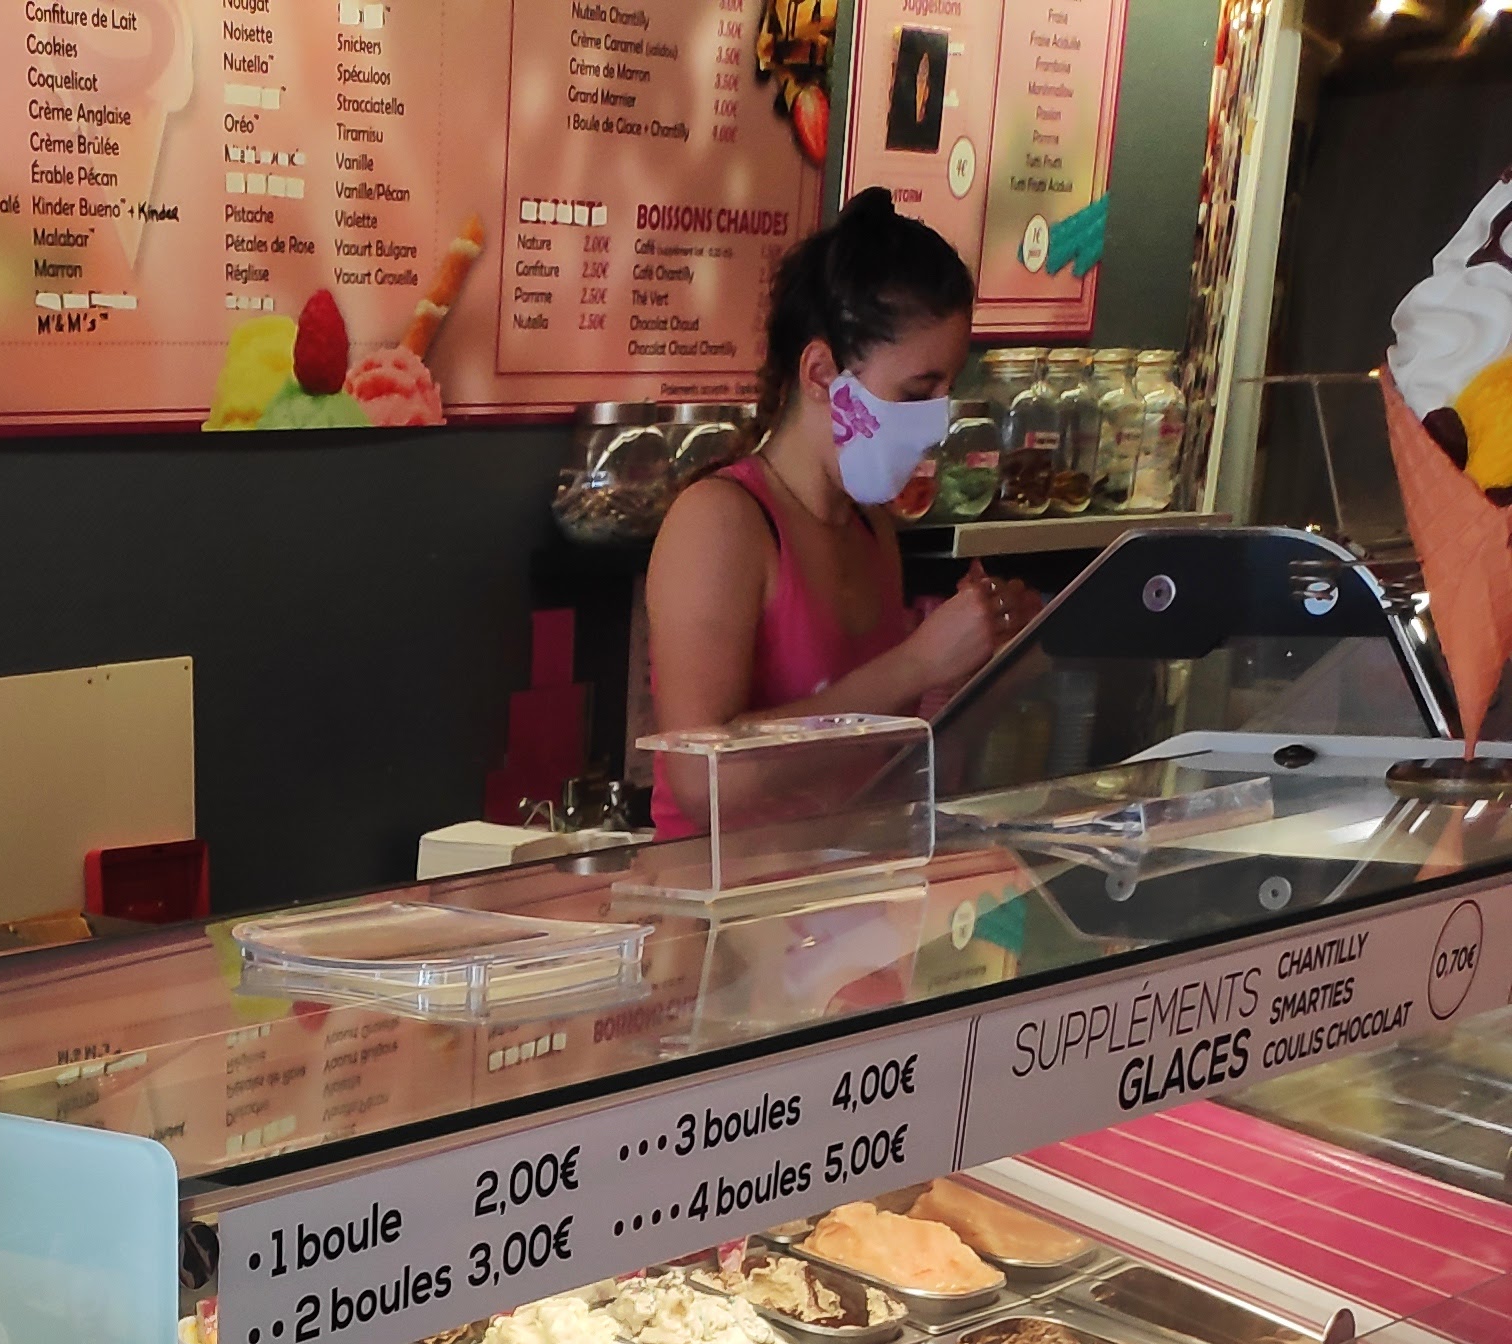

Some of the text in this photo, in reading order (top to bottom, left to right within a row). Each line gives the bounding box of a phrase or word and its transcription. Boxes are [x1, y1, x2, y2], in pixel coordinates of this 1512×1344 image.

[25, 0, 138, 31] Confiture de Lait
[571, 1, 650, 31] Nutella Chantilly
[223, 20, 273, 44] Noisette
[337, 33, 382, 56] Snickers
[570, 29, 644, 55] Crème Caramel
[26, 33, 78, 58] Cookies
[27, 66, 99, 93] Coquelicot
[337, 63, 391, 86] Spéculoos
[569, 57, 651, 83] Crème de Marron
[337, 93, 405, 116] Stracciatella
[568, 85, 599, 104] Grand
[28, 99, 131, 127] Crème Anglaise
[336, 122, 384, 144] Tiramisu
[573, 113, 600, 132] Boule
[601, 116, 614, 134] de
[615, 117, 642, 136] Glace
[650, 120, 690, 143] Chantilly
[29, 131, 120, 156] Crème Brûlée
[30, 159, 118, 187] Érable Pécan
[336, 151, 374, 172] Vanille
[32, 195, 75, 217] Kinder
[225, 204, 274, 224] Pistache
[335, 210, 378, 229] Violette
[637, 204, 713, 232] BOISSONS
[716, 208, 788, 236] CHAUDES
[225, 234, 315, 255] Pétales de Rose
[334, 239, 418, 260] Yaourt Bulgare
[517, 234, 552, 251] Nature
[34, 258, 83, 278] Marron
[225, 263, 270, 284] Réglisse
[334, 267, 372, 285] Yaourt
[515, 260, 560, 279] Confiture
[1277, 931, 1370, 980] CHANTILLY
[1269, 977, 1355, 1026] SMARTIES
[1011, 967, 1263, 1077] SUPPLÉMENTS
[1262, 1002, 1413, 1069] COULIS CHOCOLAT
[1117, 1027, 1252, 1111] GLACES
[674, 1053, 919, 1156] 3 boules 4,00€
[687, 1124, 909, 1222] 4 boules 5,00€
[296, 1202, 403, 1271] boule
[474, 1145, 581, 1217] 2,00€
[295, 1215, 574, 1344] 2 boules 3,00€
